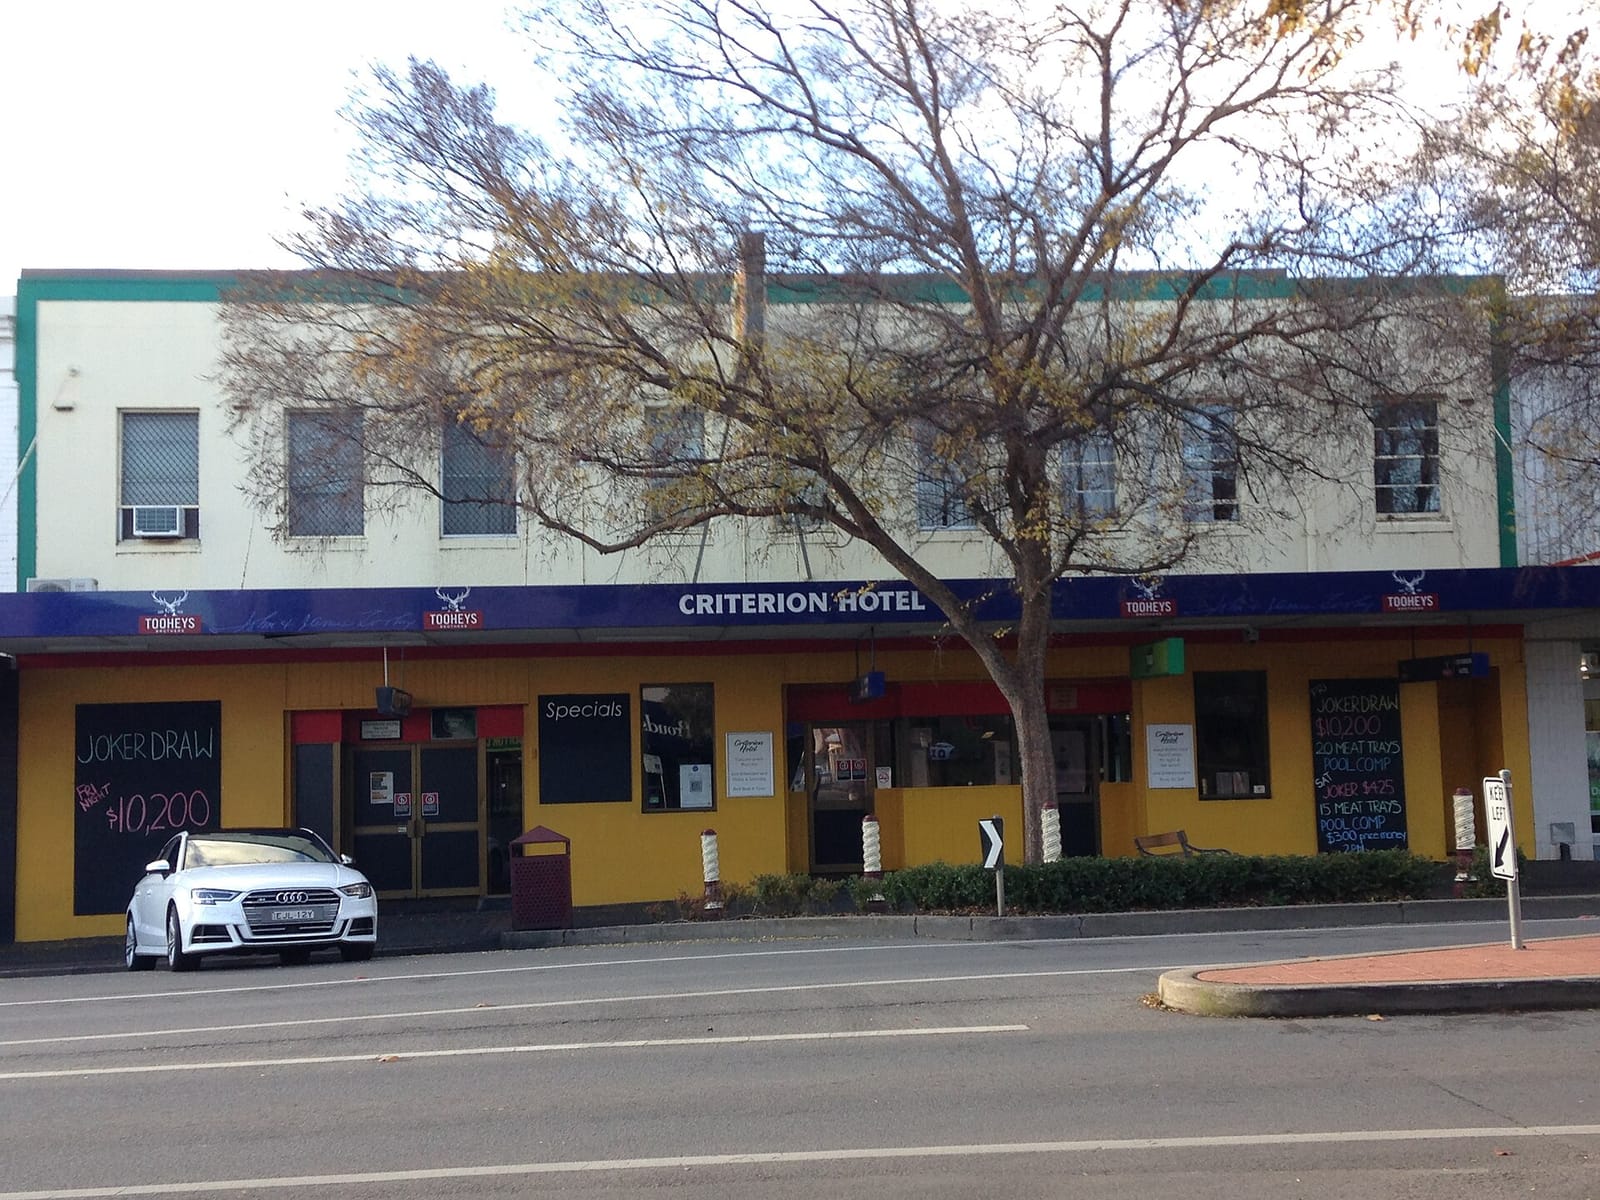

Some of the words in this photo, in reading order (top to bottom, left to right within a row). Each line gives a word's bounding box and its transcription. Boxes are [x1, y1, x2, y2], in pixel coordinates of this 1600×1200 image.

[679, 592, 827, 615] CRITERION
[839, 590, 926, 612] HOTEL
[1126, 601, 1172, 613] TOOHEYS
[1387, 595, 1434, 607] TOOHEYS
[145, 617, 196, 630] TOOHEYS
[430, 613, 478, 625] TOOHEYS
[546, 700, 622, 721] Specials
[1316, 695, 1360, 713] JOKER
[1360, 692, 1399, 713] DRAW
[1315, 715, 1381, 740] $10,200
[76, 733, 147, 764] JOKER
[151, 727, 213, 761] DRAW
[1315, 741, 1334, 755] 20
[1335, 740, 1365, 754] MEAT
[1367, 740, 1400, 754] TRAYS
[1324, 757, 1356, 772] POOL
[1356, 756, 1392, 772] COMP
[1315, 771, 1333, 788] SAT
[76, 783, 98, 800] FRI
[79, 782, 111, 812] NIGHT
[1322, 782, 1359, 799] JOKER
[106, 790, 210, 836] $10,200
[1320, 803, 1331, 816] 15
[1334, 801, 1363, 814] MEAT
[1366, 799, 1402, 814] TRAYS
[1491, 806, 1506, 821] LEFT
[1320, 817, 1351, 831] POOL
[1352, 815, 1386, 830] COMP
[1327, 829, 1357, 844] $300
